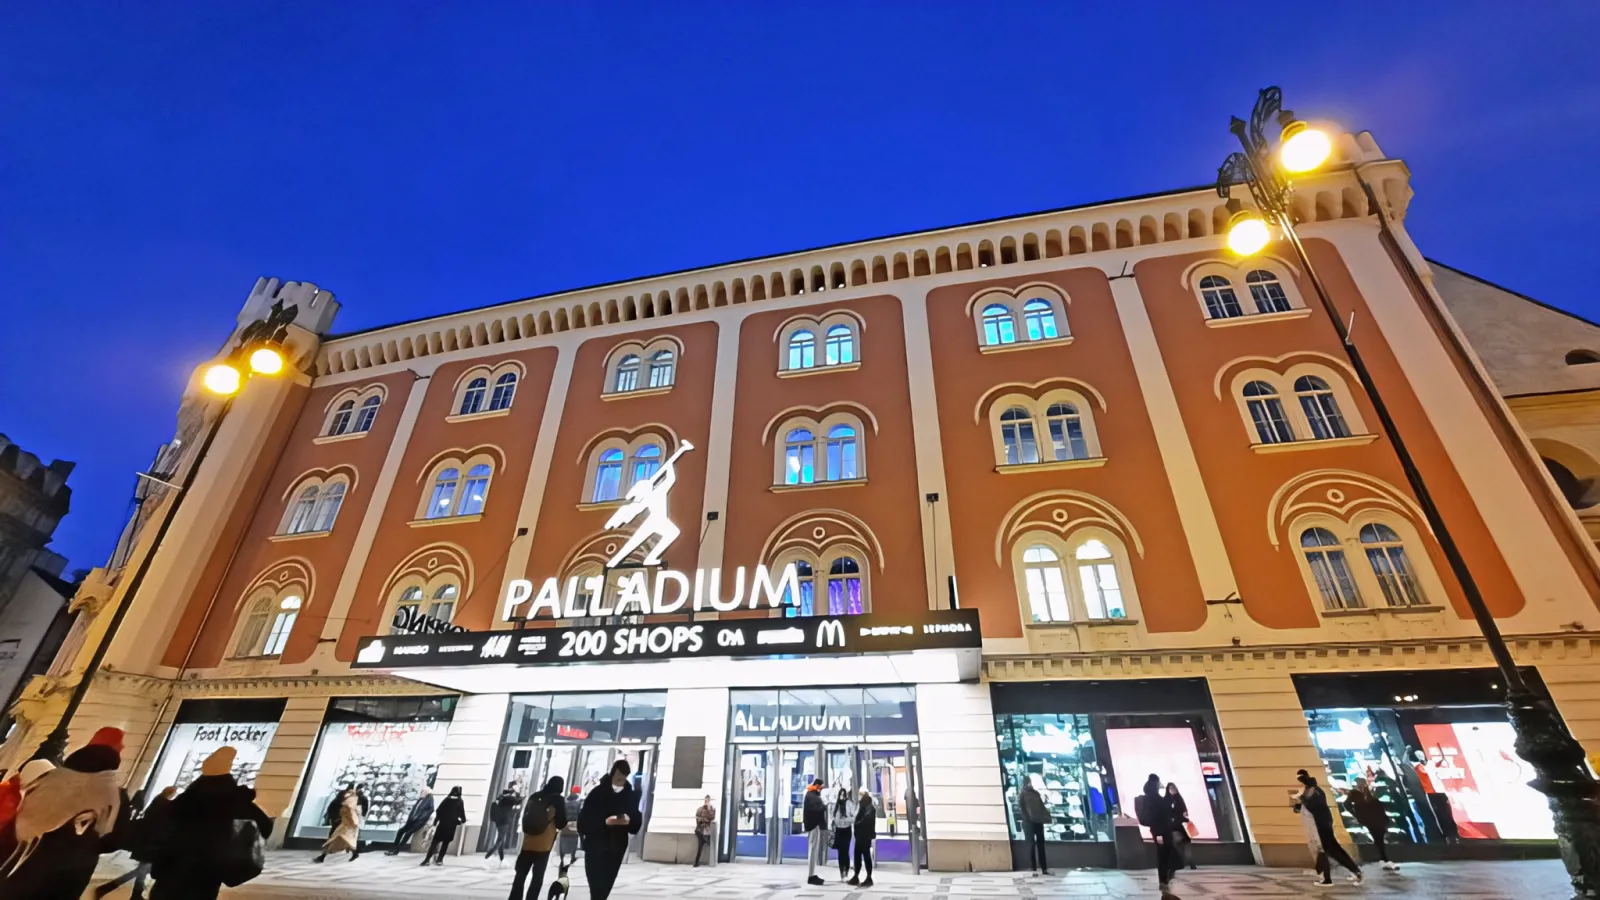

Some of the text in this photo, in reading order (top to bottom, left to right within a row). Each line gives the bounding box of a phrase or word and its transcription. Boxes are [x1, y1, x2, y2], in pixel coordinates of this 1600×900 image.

[502, 563, 801, 621] PALLADIUM
[558, 630, 606, 657] 200
[613, 625, 704, 655] SHOPS
[194, 725, 221, 742] Foot
[735, 710, 851, 731] ALLADIUM
